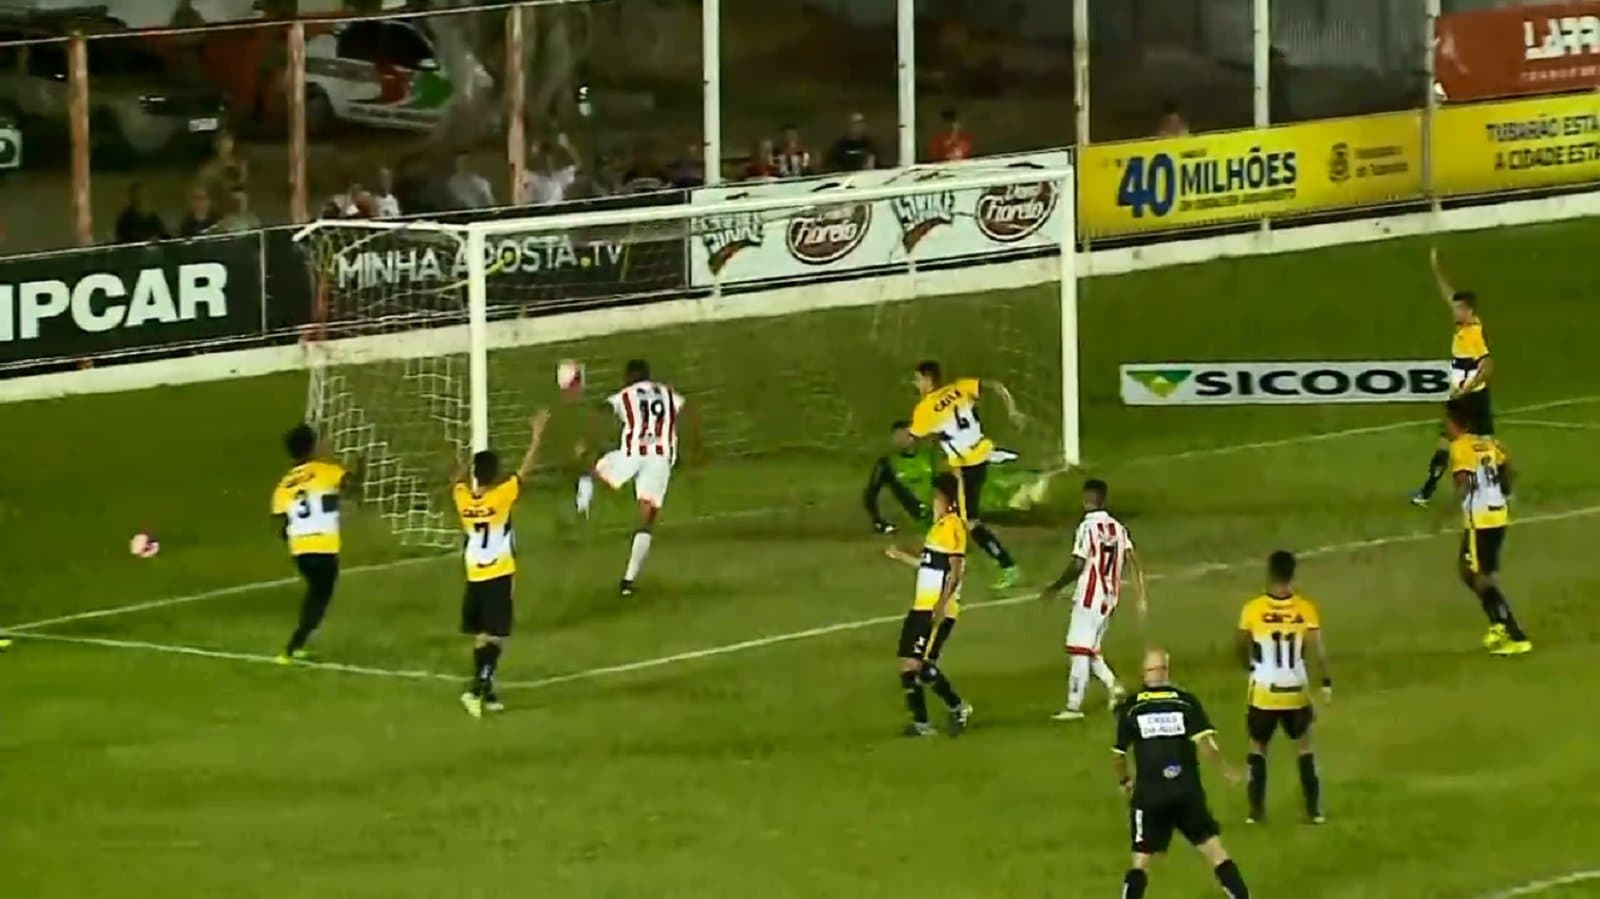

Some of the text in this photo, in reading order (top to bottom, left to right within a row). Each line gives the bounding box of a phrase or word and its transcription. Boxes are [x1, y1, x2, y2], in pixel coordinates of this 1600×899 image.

[1117, 153, 1176, 218] 40
[1179, 146, 1297, 197] MILHÕES
[338, 246, 442, 289] MINHA
[1195, 369, 1451, 397] SICOOB
[640, 399, 666, 427] 19
[296, 489, 311, 519] 3
[474, 522, 490, 549] 7
[1102, 543, 1119, 577] 7
[1271, 630, 1298, 669] 11
